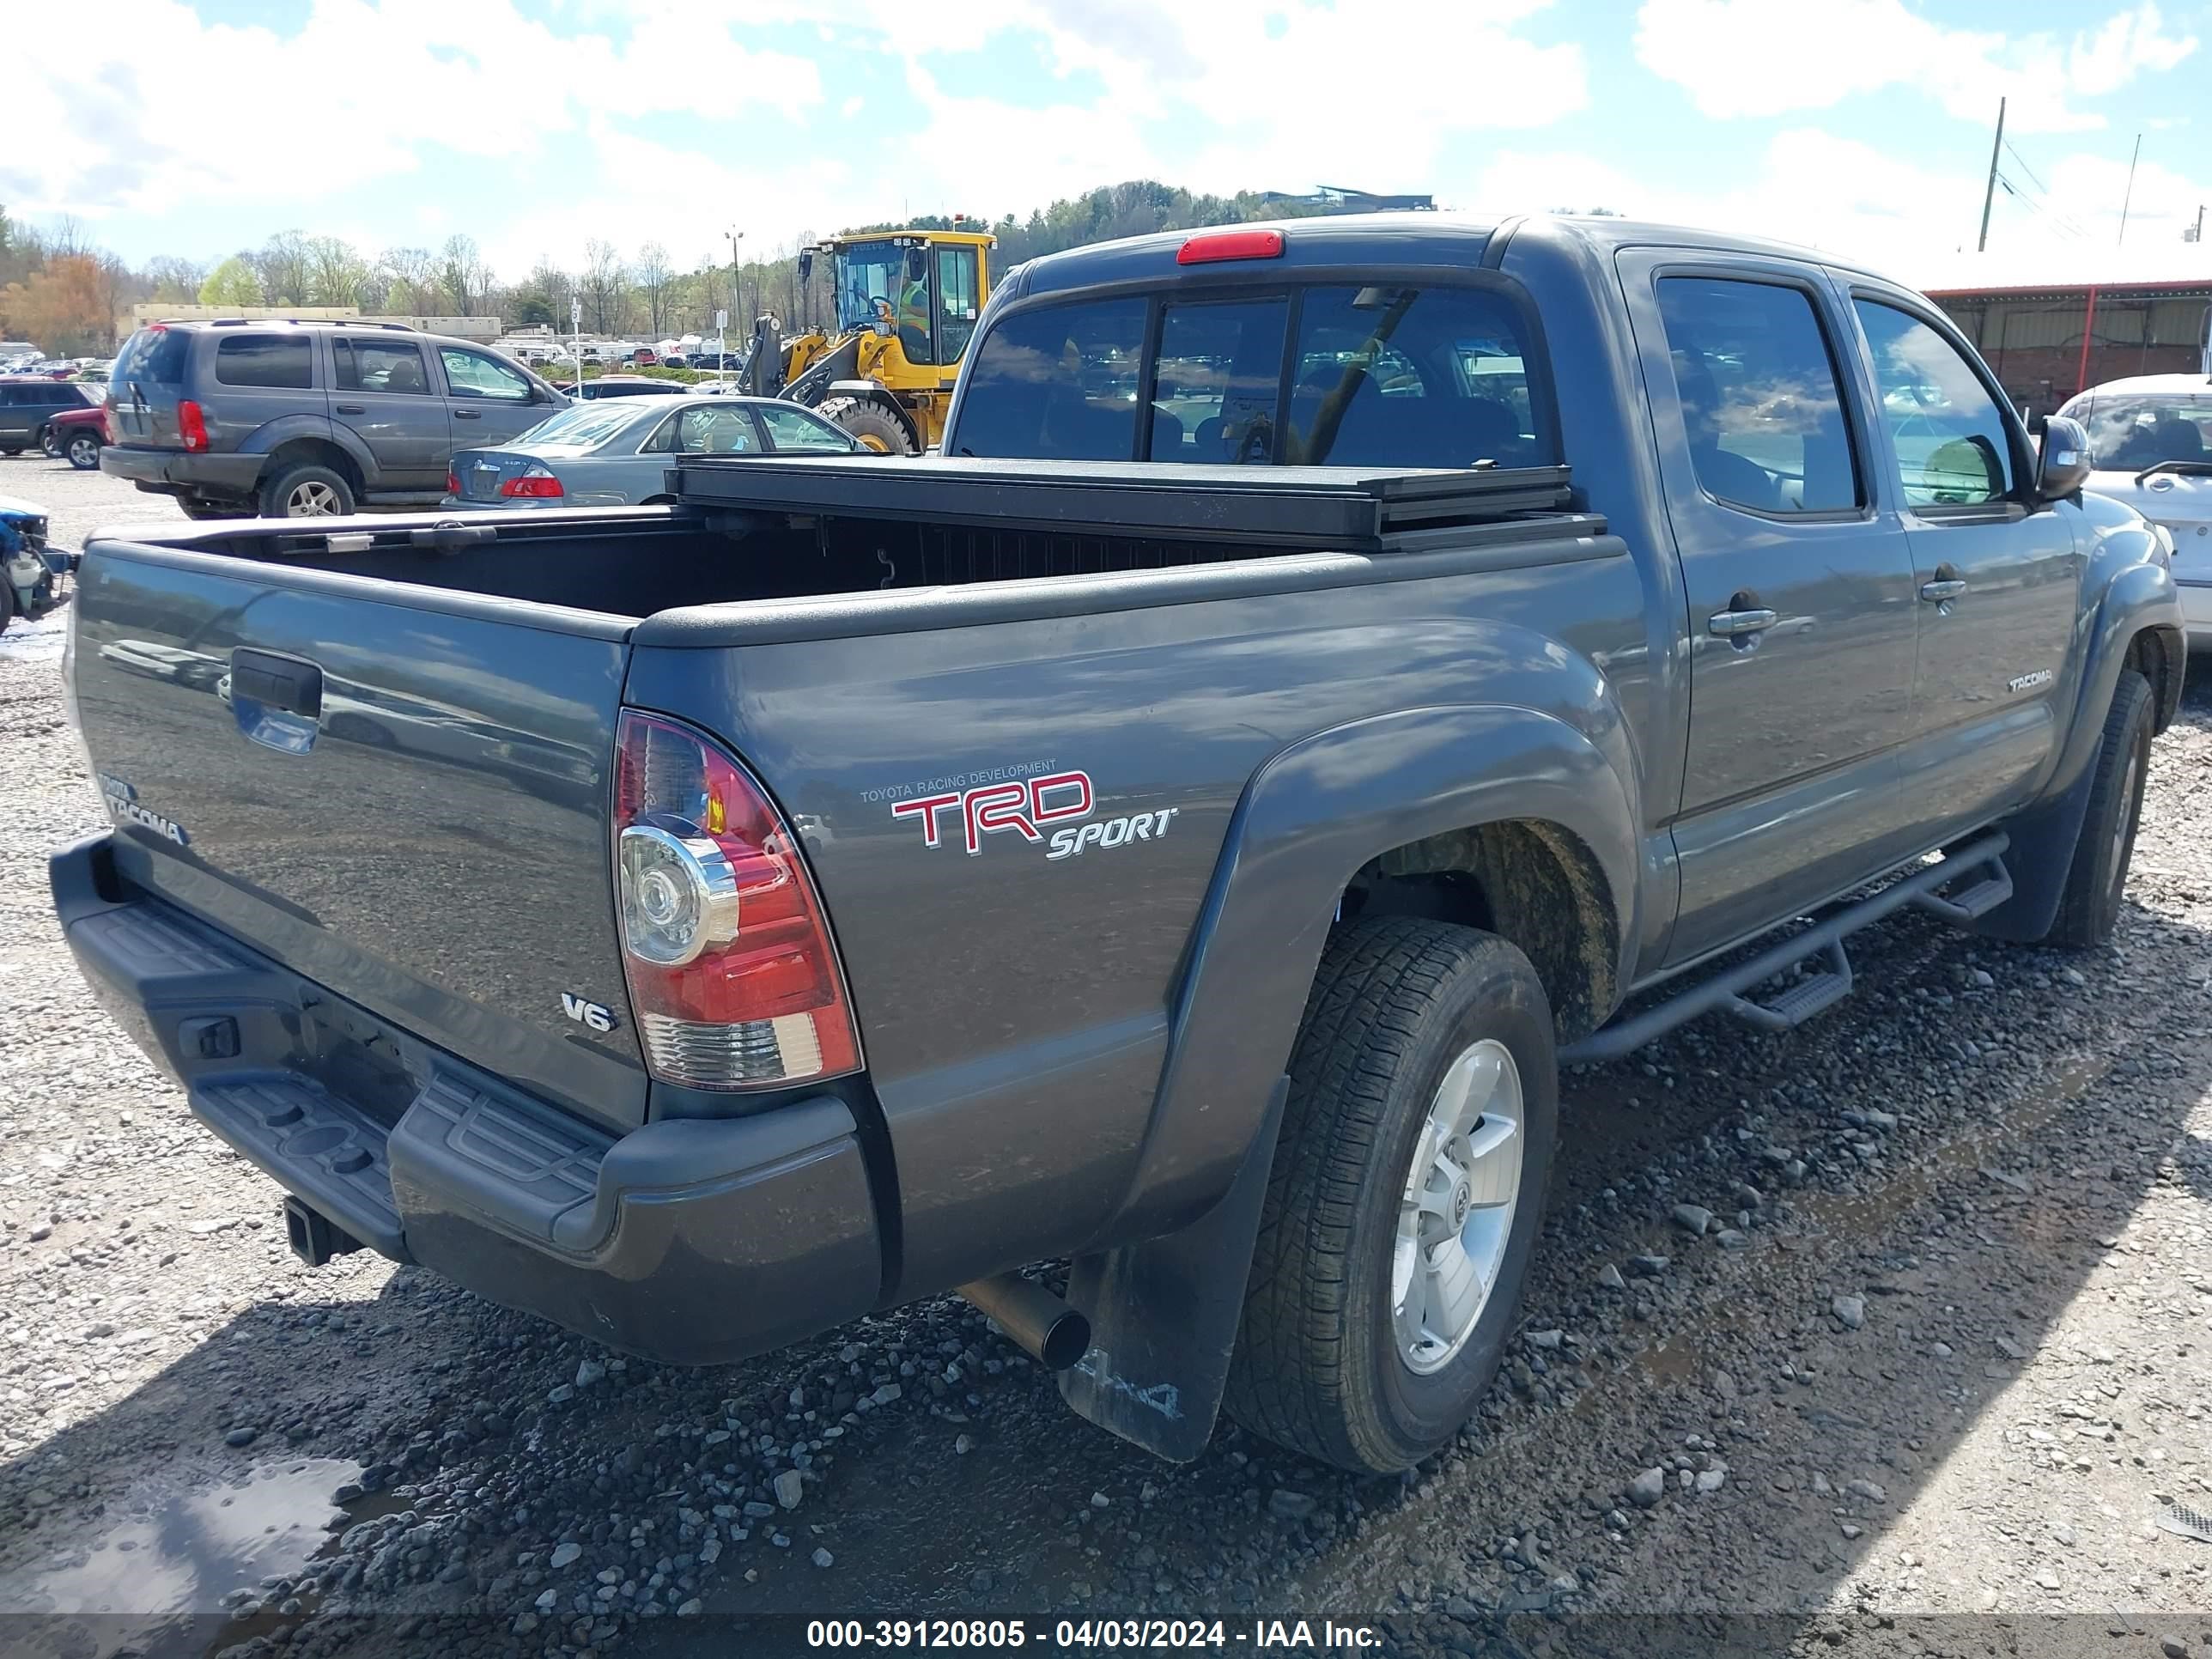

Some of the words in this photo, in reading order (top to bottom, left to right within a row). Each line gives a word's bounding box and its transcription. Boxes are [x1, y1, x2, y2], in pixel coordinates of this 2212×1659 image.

[853, 242, 886, 252] VOLVO
[2009, 669, 2053, 693] TACOMA
[860, 783, 913, 804] TOYOTA
[917, 775, 967, 794] RACING
[969, 757, 1058, 785] DEVELOPMENT
[104, 793, 185, 846] TACOMA
[890, 769, 1096, 856] TRD
[1045, 807, 1179, 860] SPORT
[561, 991, 615, 1032] V6
